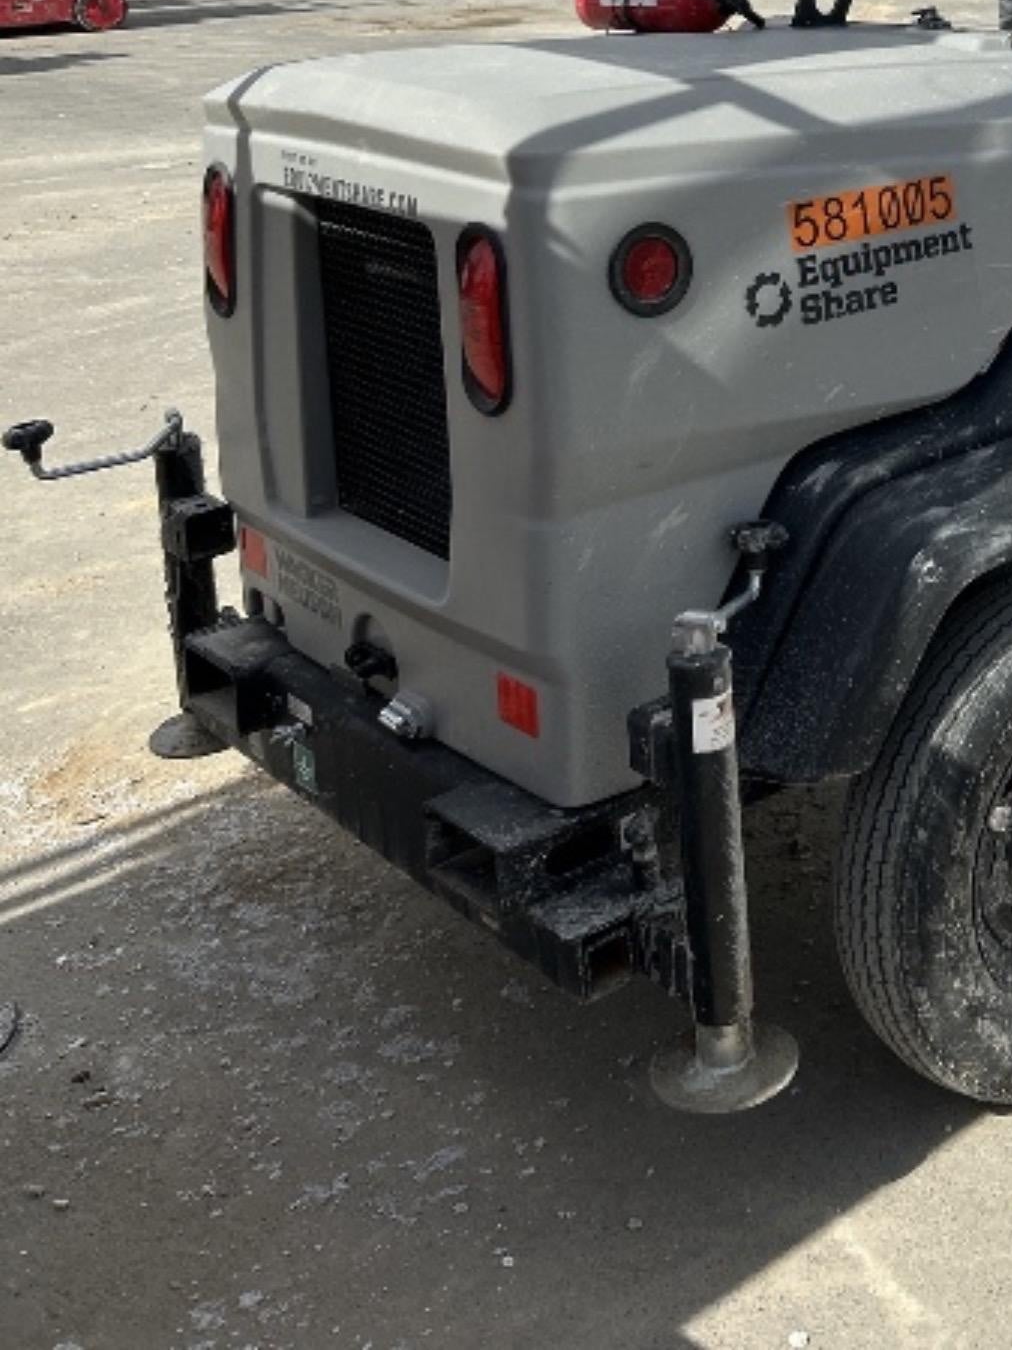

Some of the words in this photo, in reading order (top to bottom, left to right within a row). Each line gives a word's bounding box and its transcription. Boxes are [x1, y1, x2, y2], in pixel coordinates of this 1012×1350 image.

[793, 176, 952, 248] 581005
[796, 222, 973, 289] Equipment
[801, 281, 898, 326] Share
